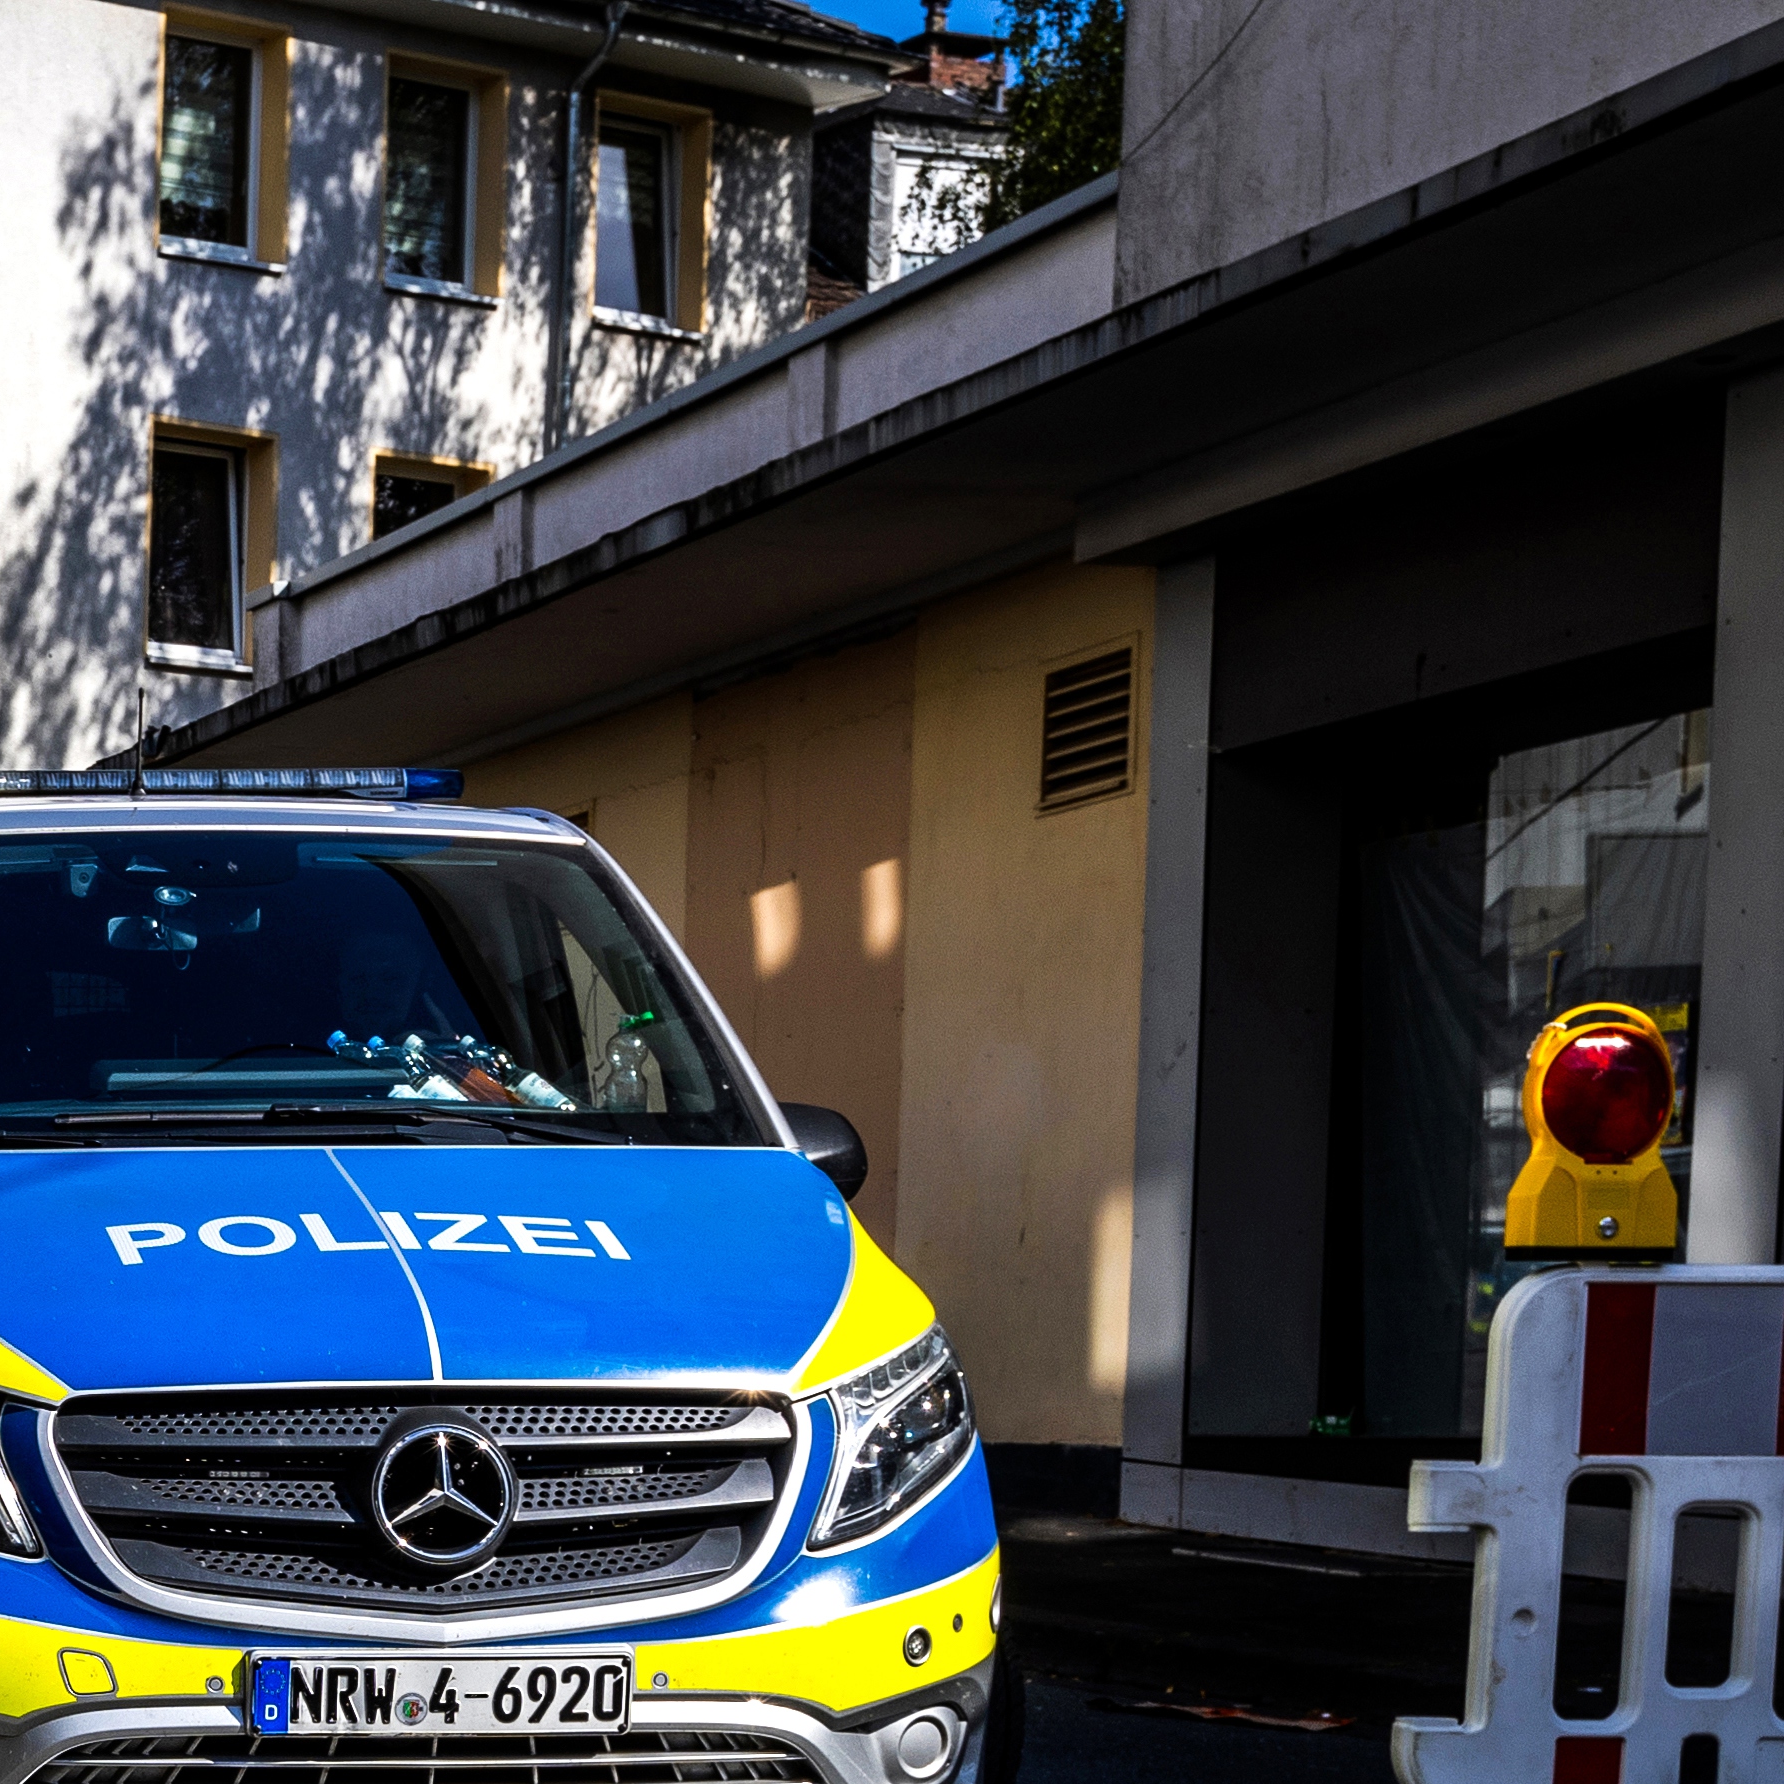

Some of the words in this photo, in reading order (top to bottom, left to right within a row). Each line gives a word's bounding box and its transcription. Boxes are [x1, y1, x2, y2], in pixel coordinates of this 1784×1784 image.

[105, 1210, 632, 1266] POLIZEI
[265, 1704, 278, 1721] D
[290, 1665, 397, 1725] NRW
